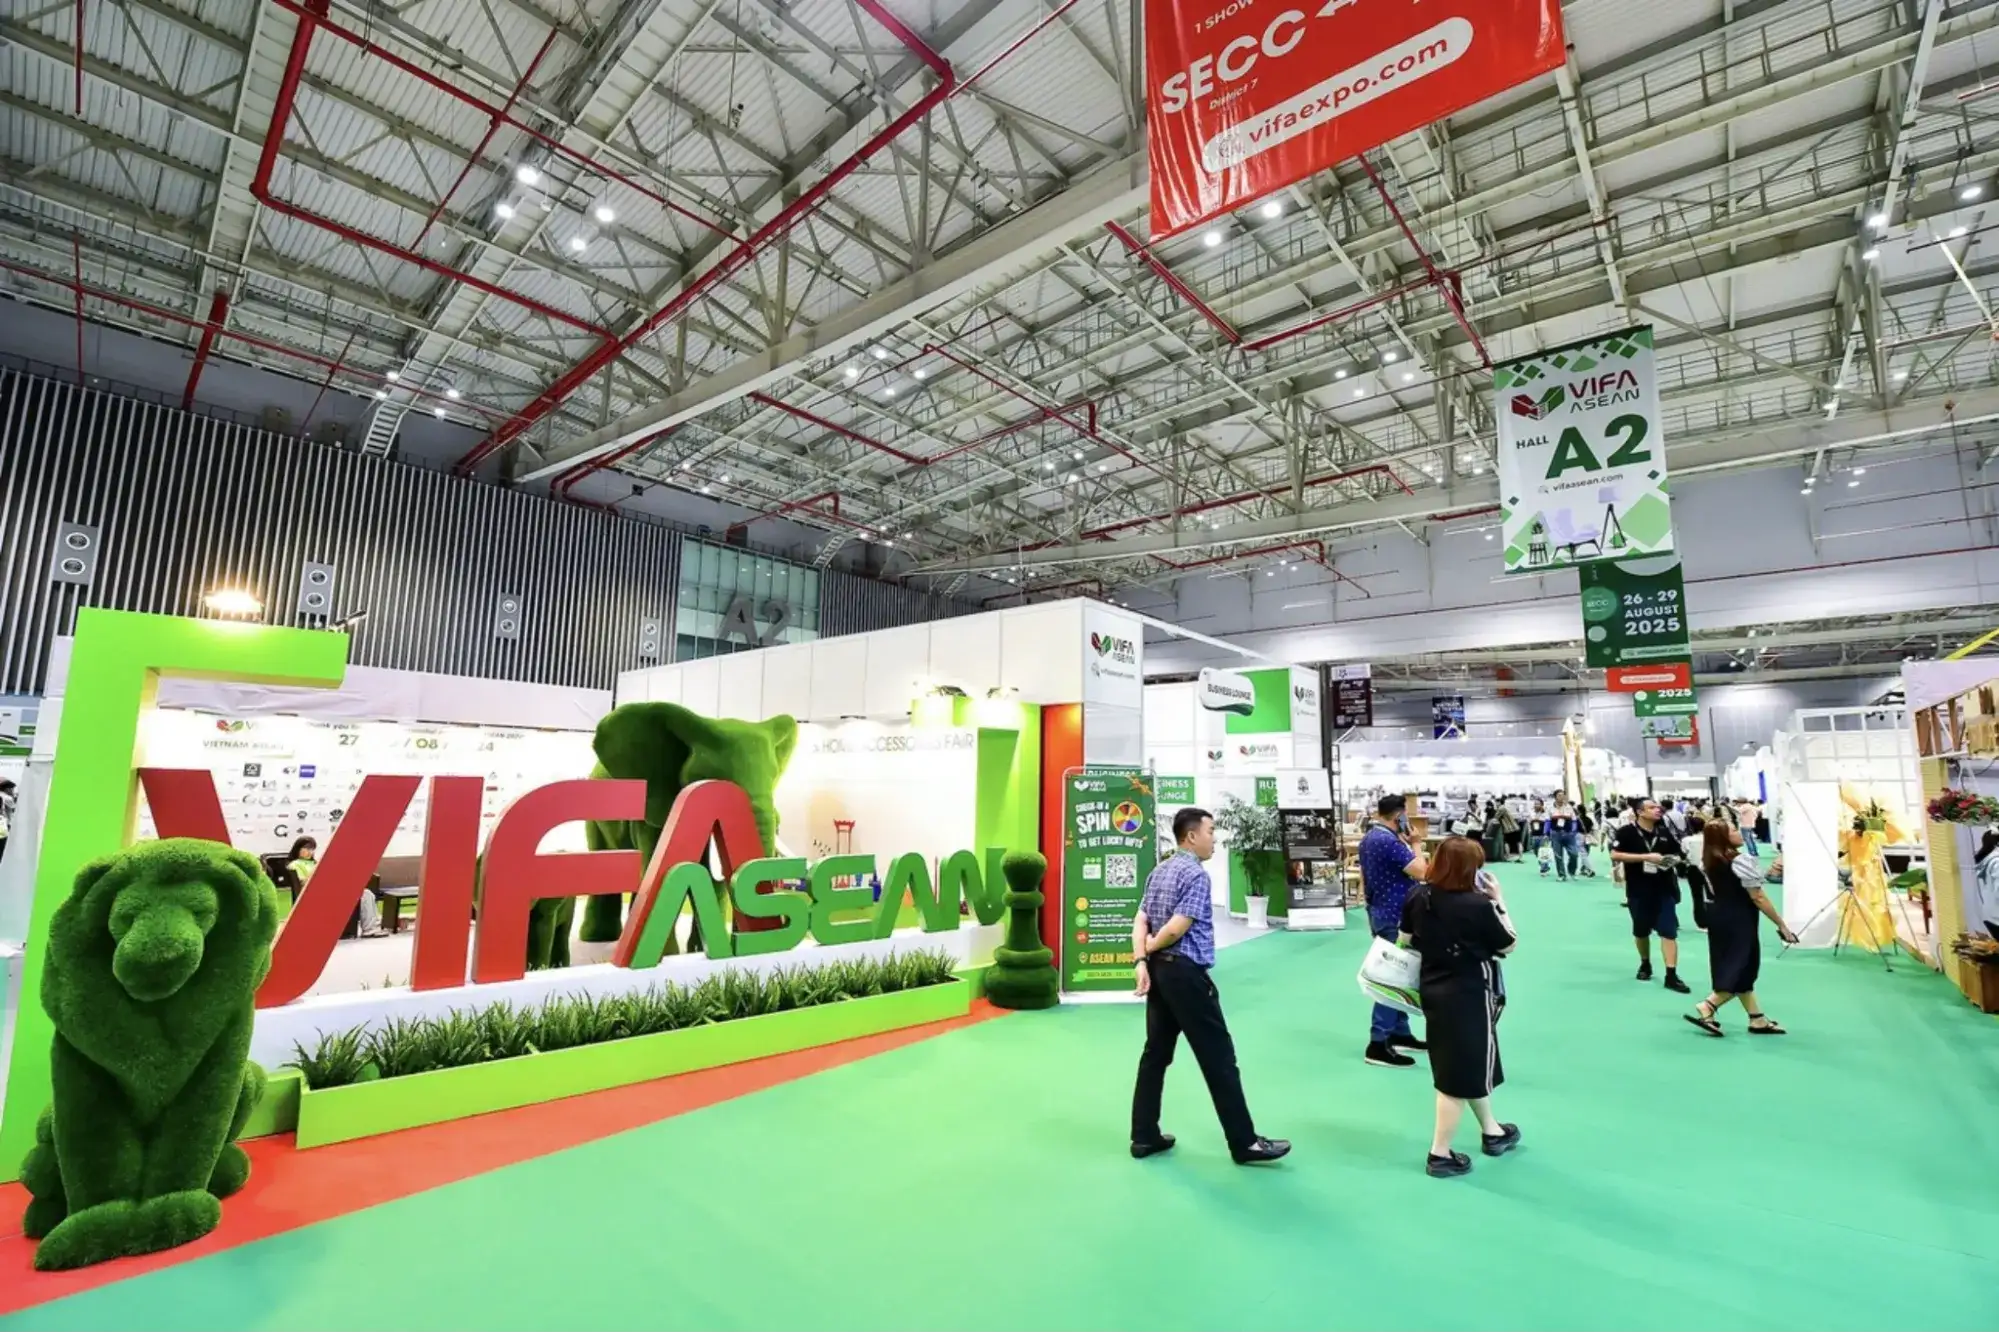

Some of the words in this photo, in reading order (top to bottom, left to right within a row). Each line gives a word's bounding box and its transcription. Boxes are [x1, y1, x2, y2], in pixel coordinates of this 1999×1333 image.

[1162, 9, 1306, 114] SECC
[1249, 38, 1448, 144] vifaexpo.com
[1568, 369, 1638, 398] VIFA
[1569, 388, 1640, 414] ASEAN
[1516, 435, 1549, 450] HALL
[1545, 413, 1652, 480] A2
[1553, 472, 1624, 492] vifaasean.com
[1623, 593, 1643, 606] 26
[1657, 589, 1678, 602] 29
[718, 595, 791, 645] A2
[1625, 605, 1679, 618] AUGUST
[1625, 617, 1681, 636] 2025
[1207, 683, 1231, 697] BUSINESS
[202, 740, 249, 749] VIETNAM
[338, 734, 359, 746] 27
[944, 733, 974, 749] FAIR
[1076, 811, 1110, 835] SPIN
[138, 767, 785, 1010] VIFA
[629, 847, 1007, 970] ASEAN
